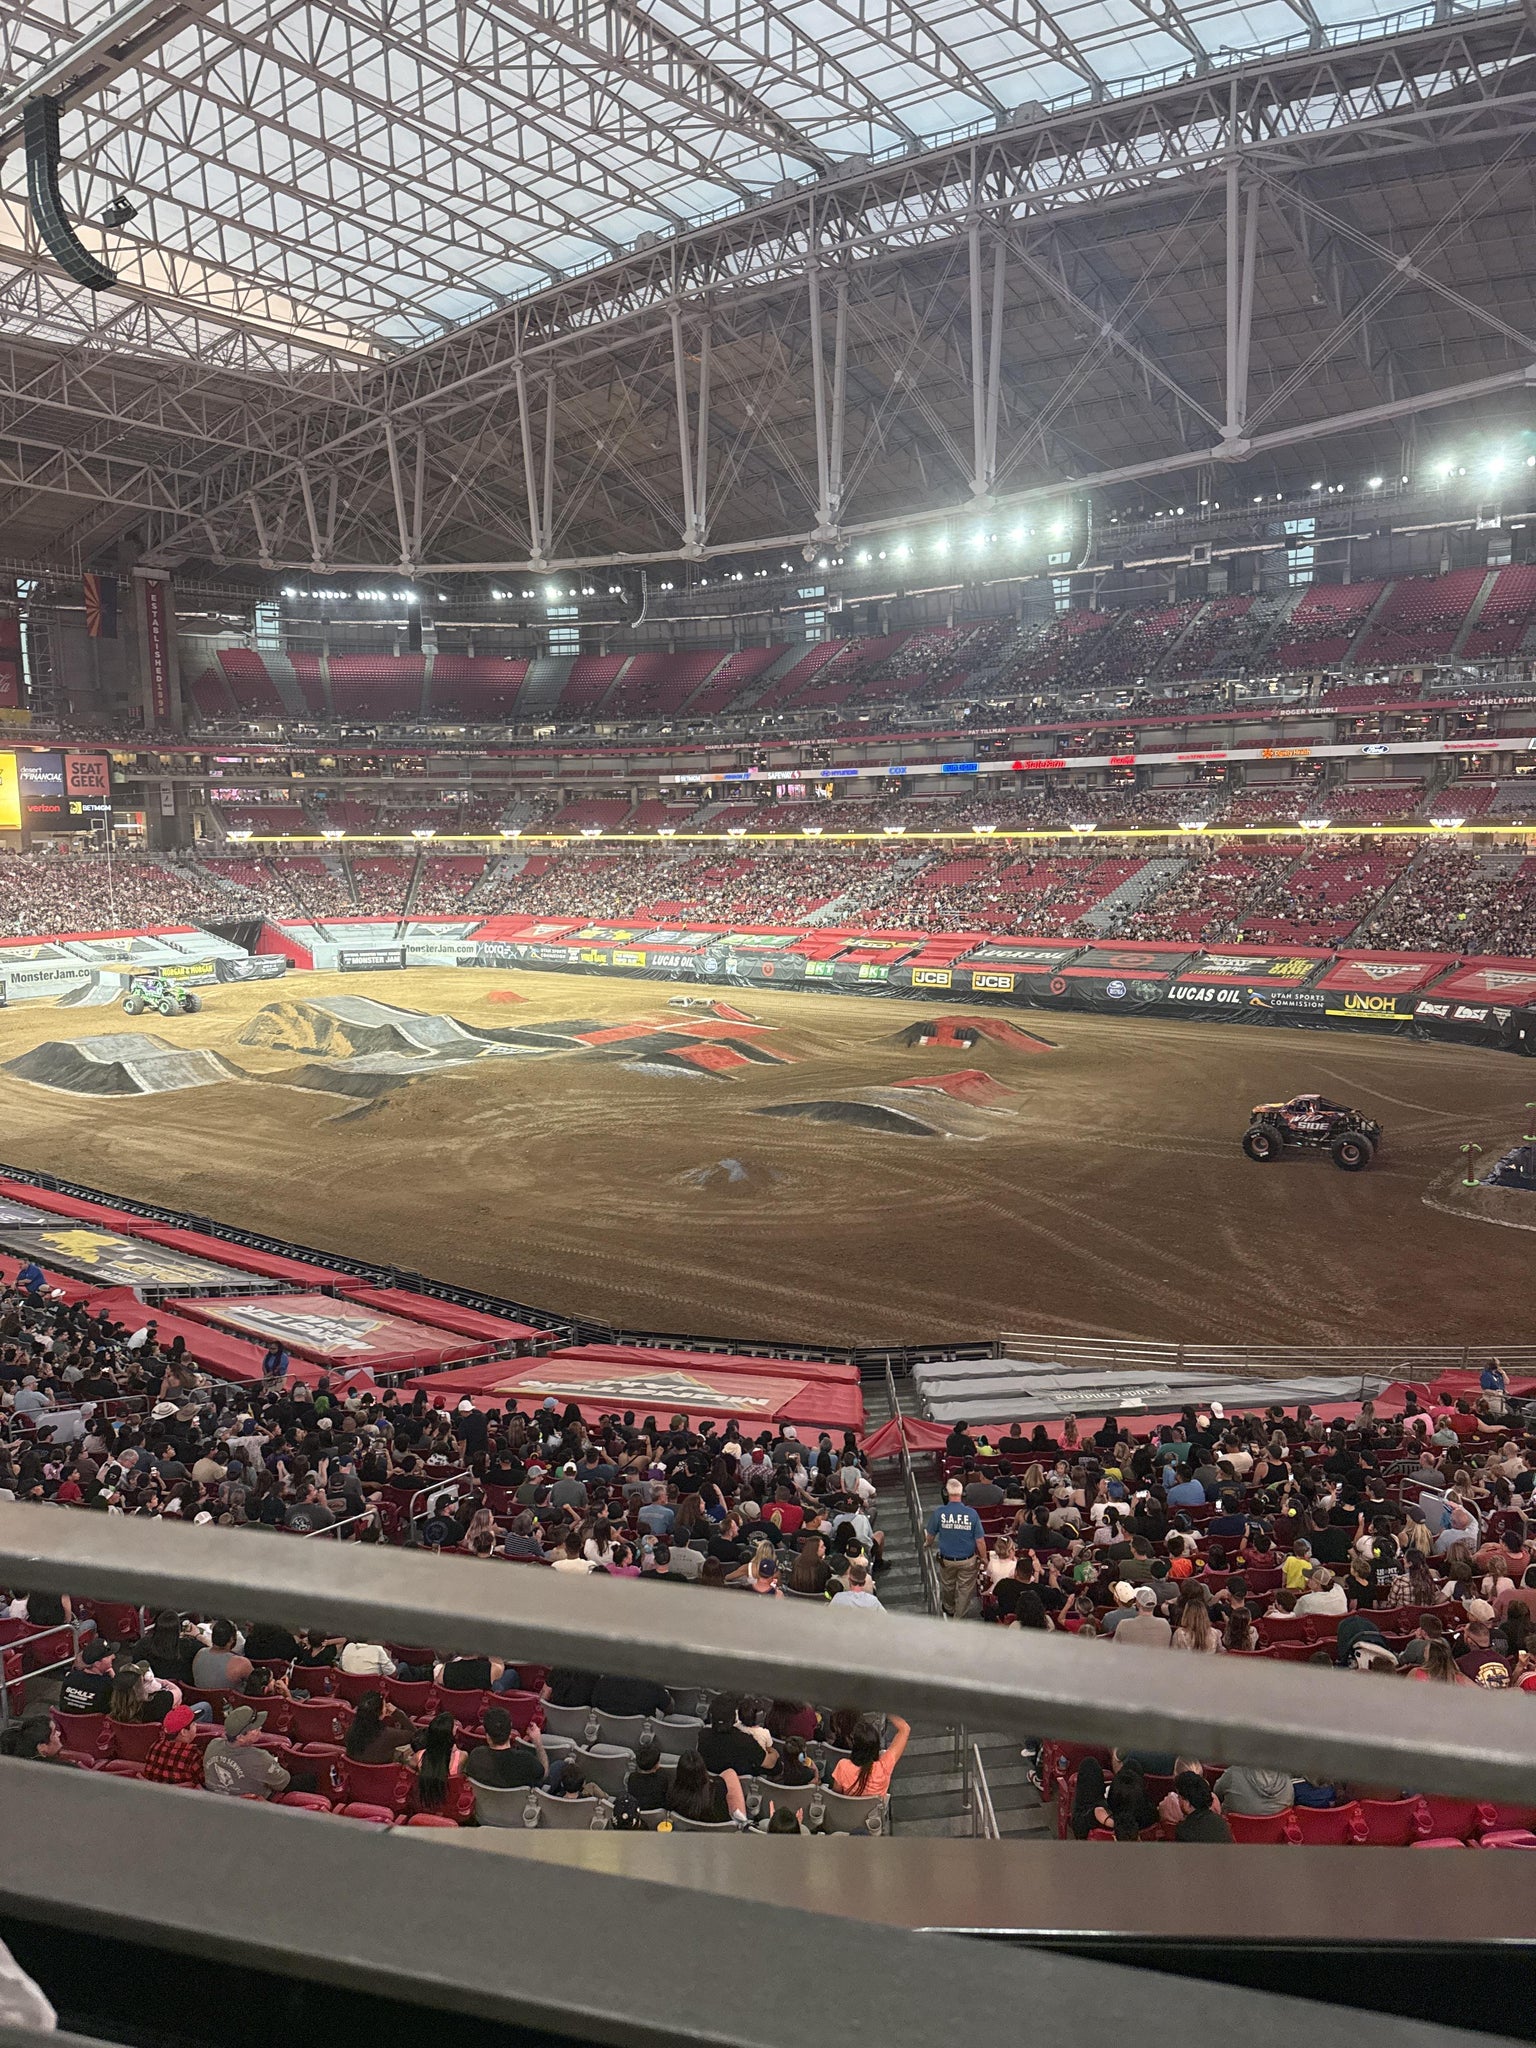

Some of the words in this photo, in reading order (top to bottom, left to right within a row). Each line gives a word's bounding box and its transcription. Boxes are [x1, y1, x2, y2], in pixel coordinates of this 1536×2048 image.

[151, 595, 163, 682] ESTABLISHED
[1469, 698, 1510, 706] CHARLEY
[71, 762, 103, 775] SEAT
[768, 771, 793, 780] SAFEWAY
[71, 776, 105, 788] GEEK
[27, 804, 60, 812] verizon
[652, 955, 680, 967] LUCAS
[680, 957, 695, 968] OIL
[805, 962, 835, 976] BKT
[859, 964, 890, 979] BKT
[11, 968, 90, 983] MonsterJam.co
[915, 972, 948, 984] JCB
[975, 976, 1011, 988] JCB
[1167, 986, 1216, 1001] LUCAS
[1216, 989, 1240, 1003] OIL
[1270, 1000, 1324, 1008] COMMISSION
[1344, 994, 1396, 1011] UNOH
[1297, 1122, 1329, 1130] SIDE
[940, 1513, 972, 1525] S.A.F.E.
[66, 1686, 96, 1699] SCHULZ
